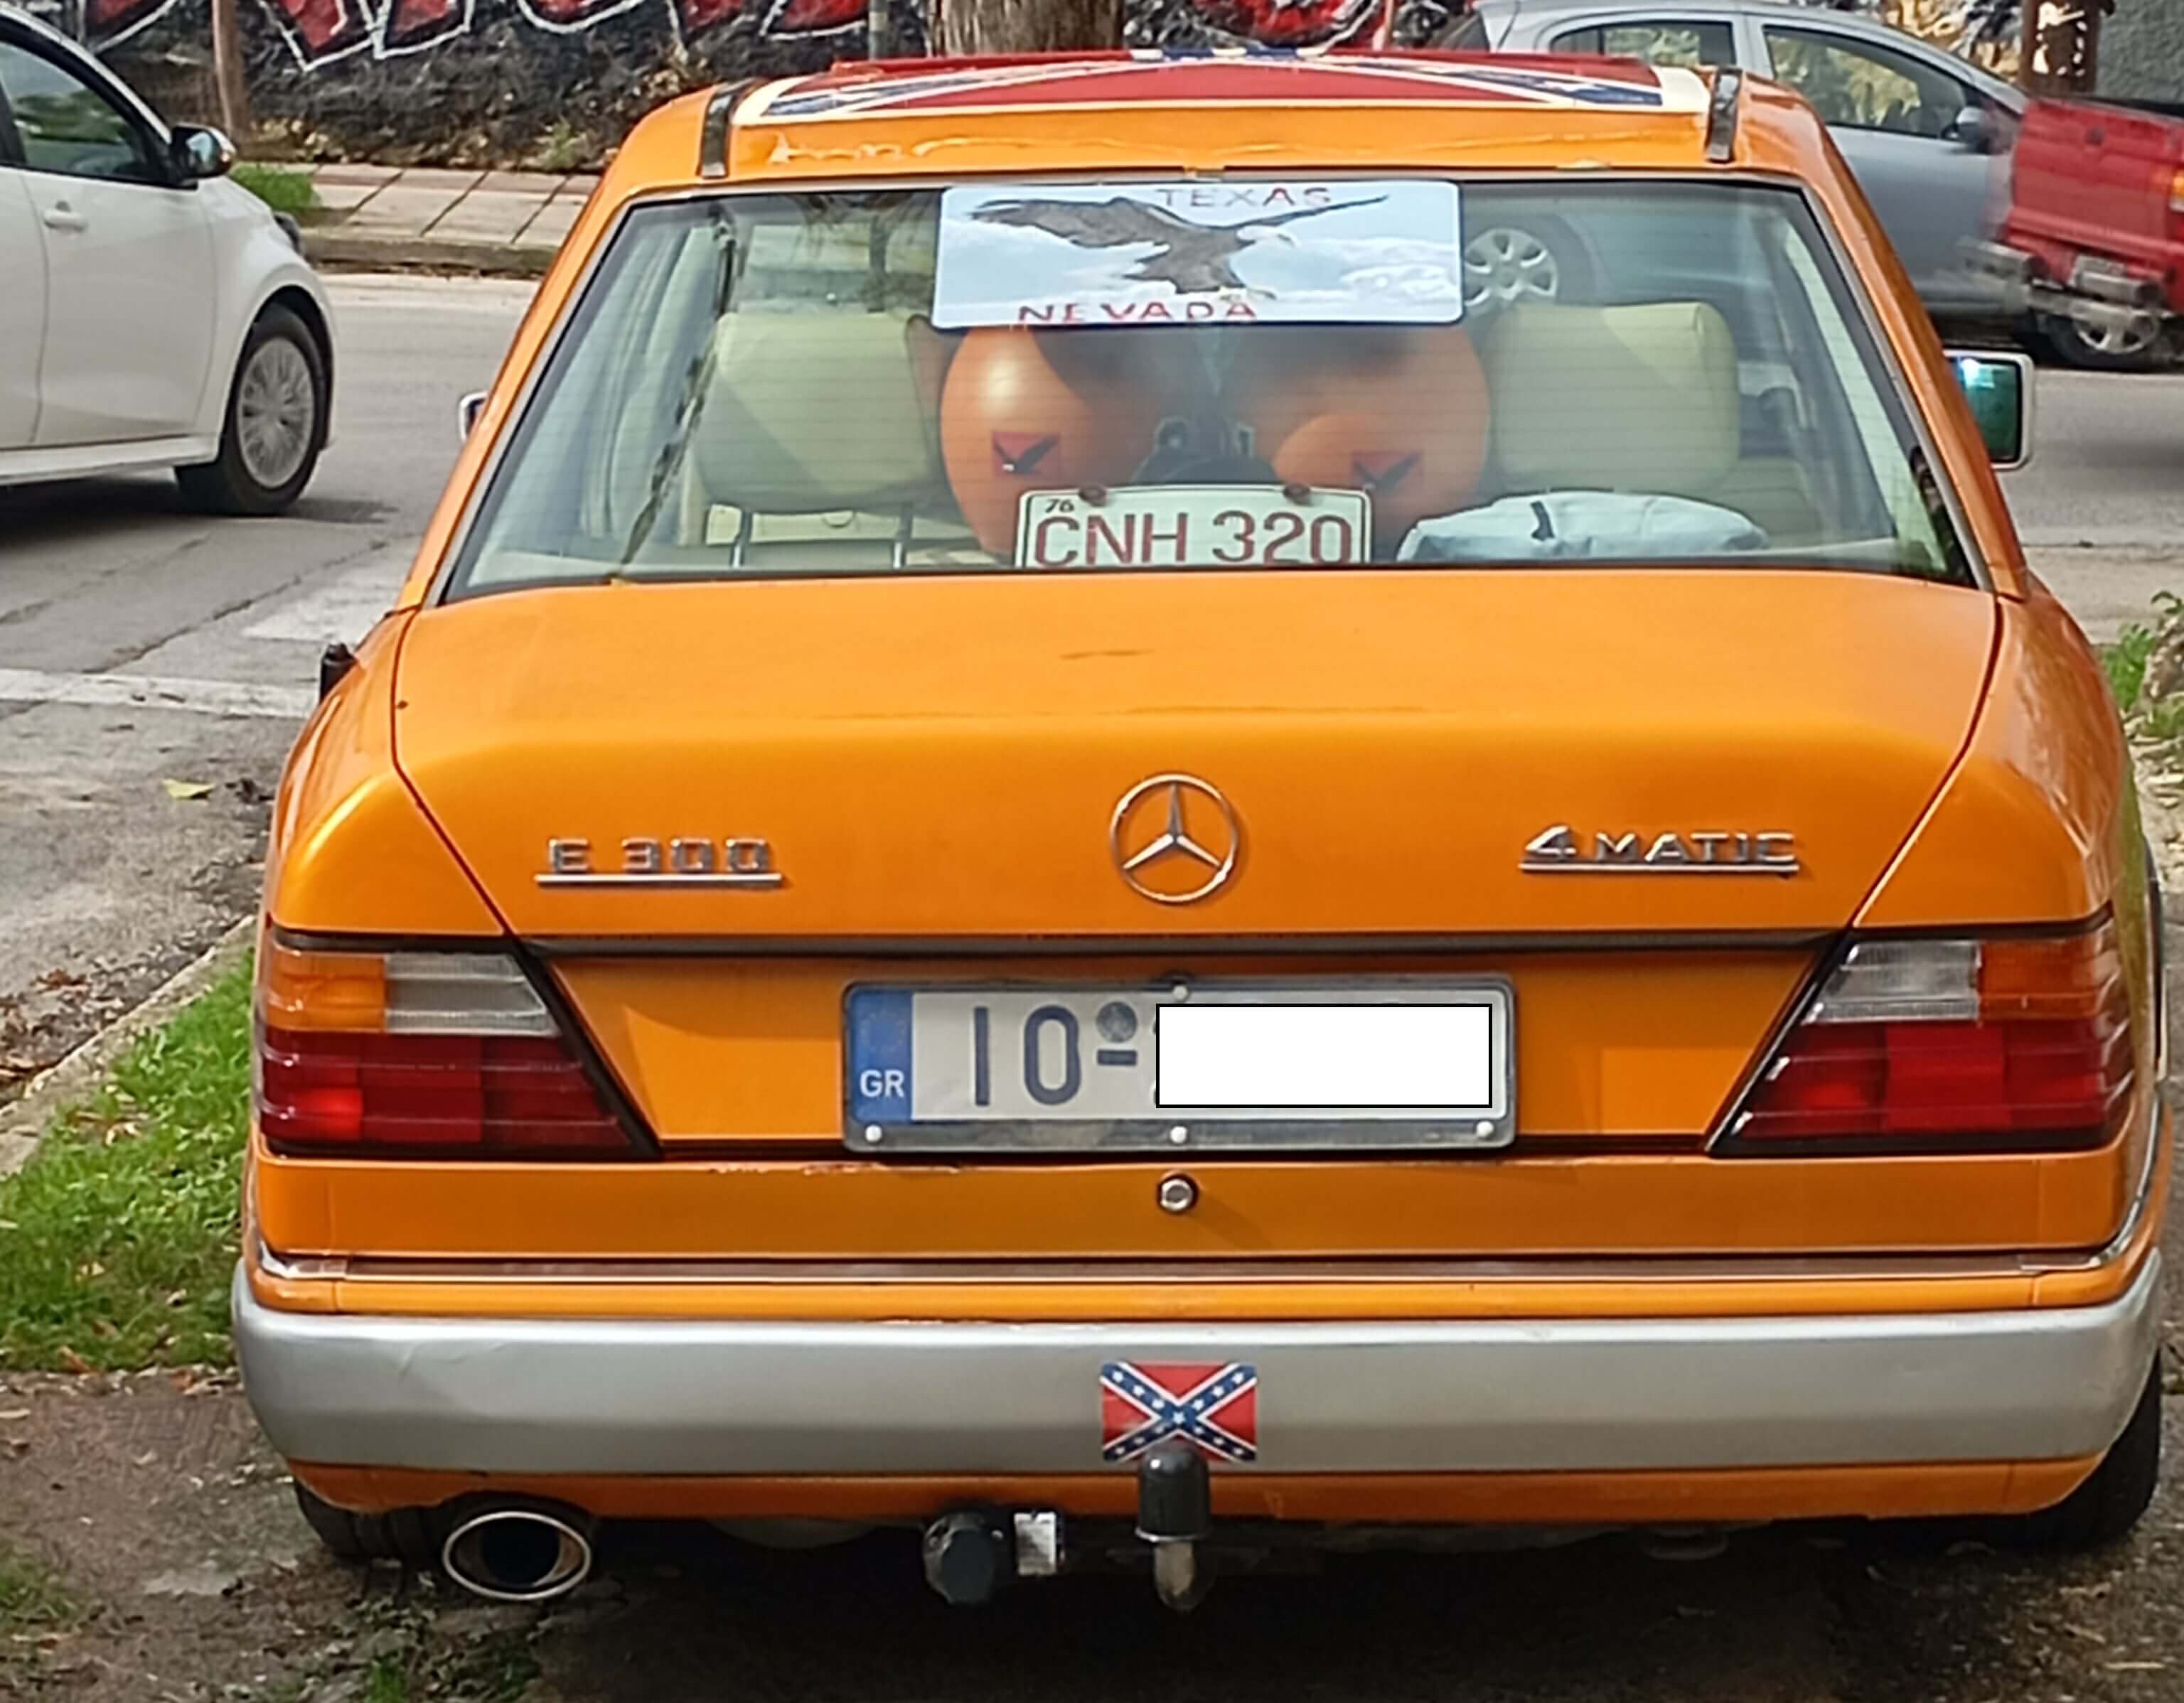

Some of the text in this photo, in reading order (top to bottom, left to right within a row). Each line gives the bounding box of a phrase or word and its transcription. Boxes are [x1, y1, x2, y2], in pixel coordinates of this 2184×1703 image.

[1155, 185, 1333, 209] TEXAS
[1017, 301, 1258, 323] NEVADA
[1045, 498, 1074, 514] 76
[1034, 510, 1352, 567] CNH 320
[549, 837, 769, 873] E 300
[1595, 832, 1795, 862] MATIC
[860, 1069, 905, 1097] GR
